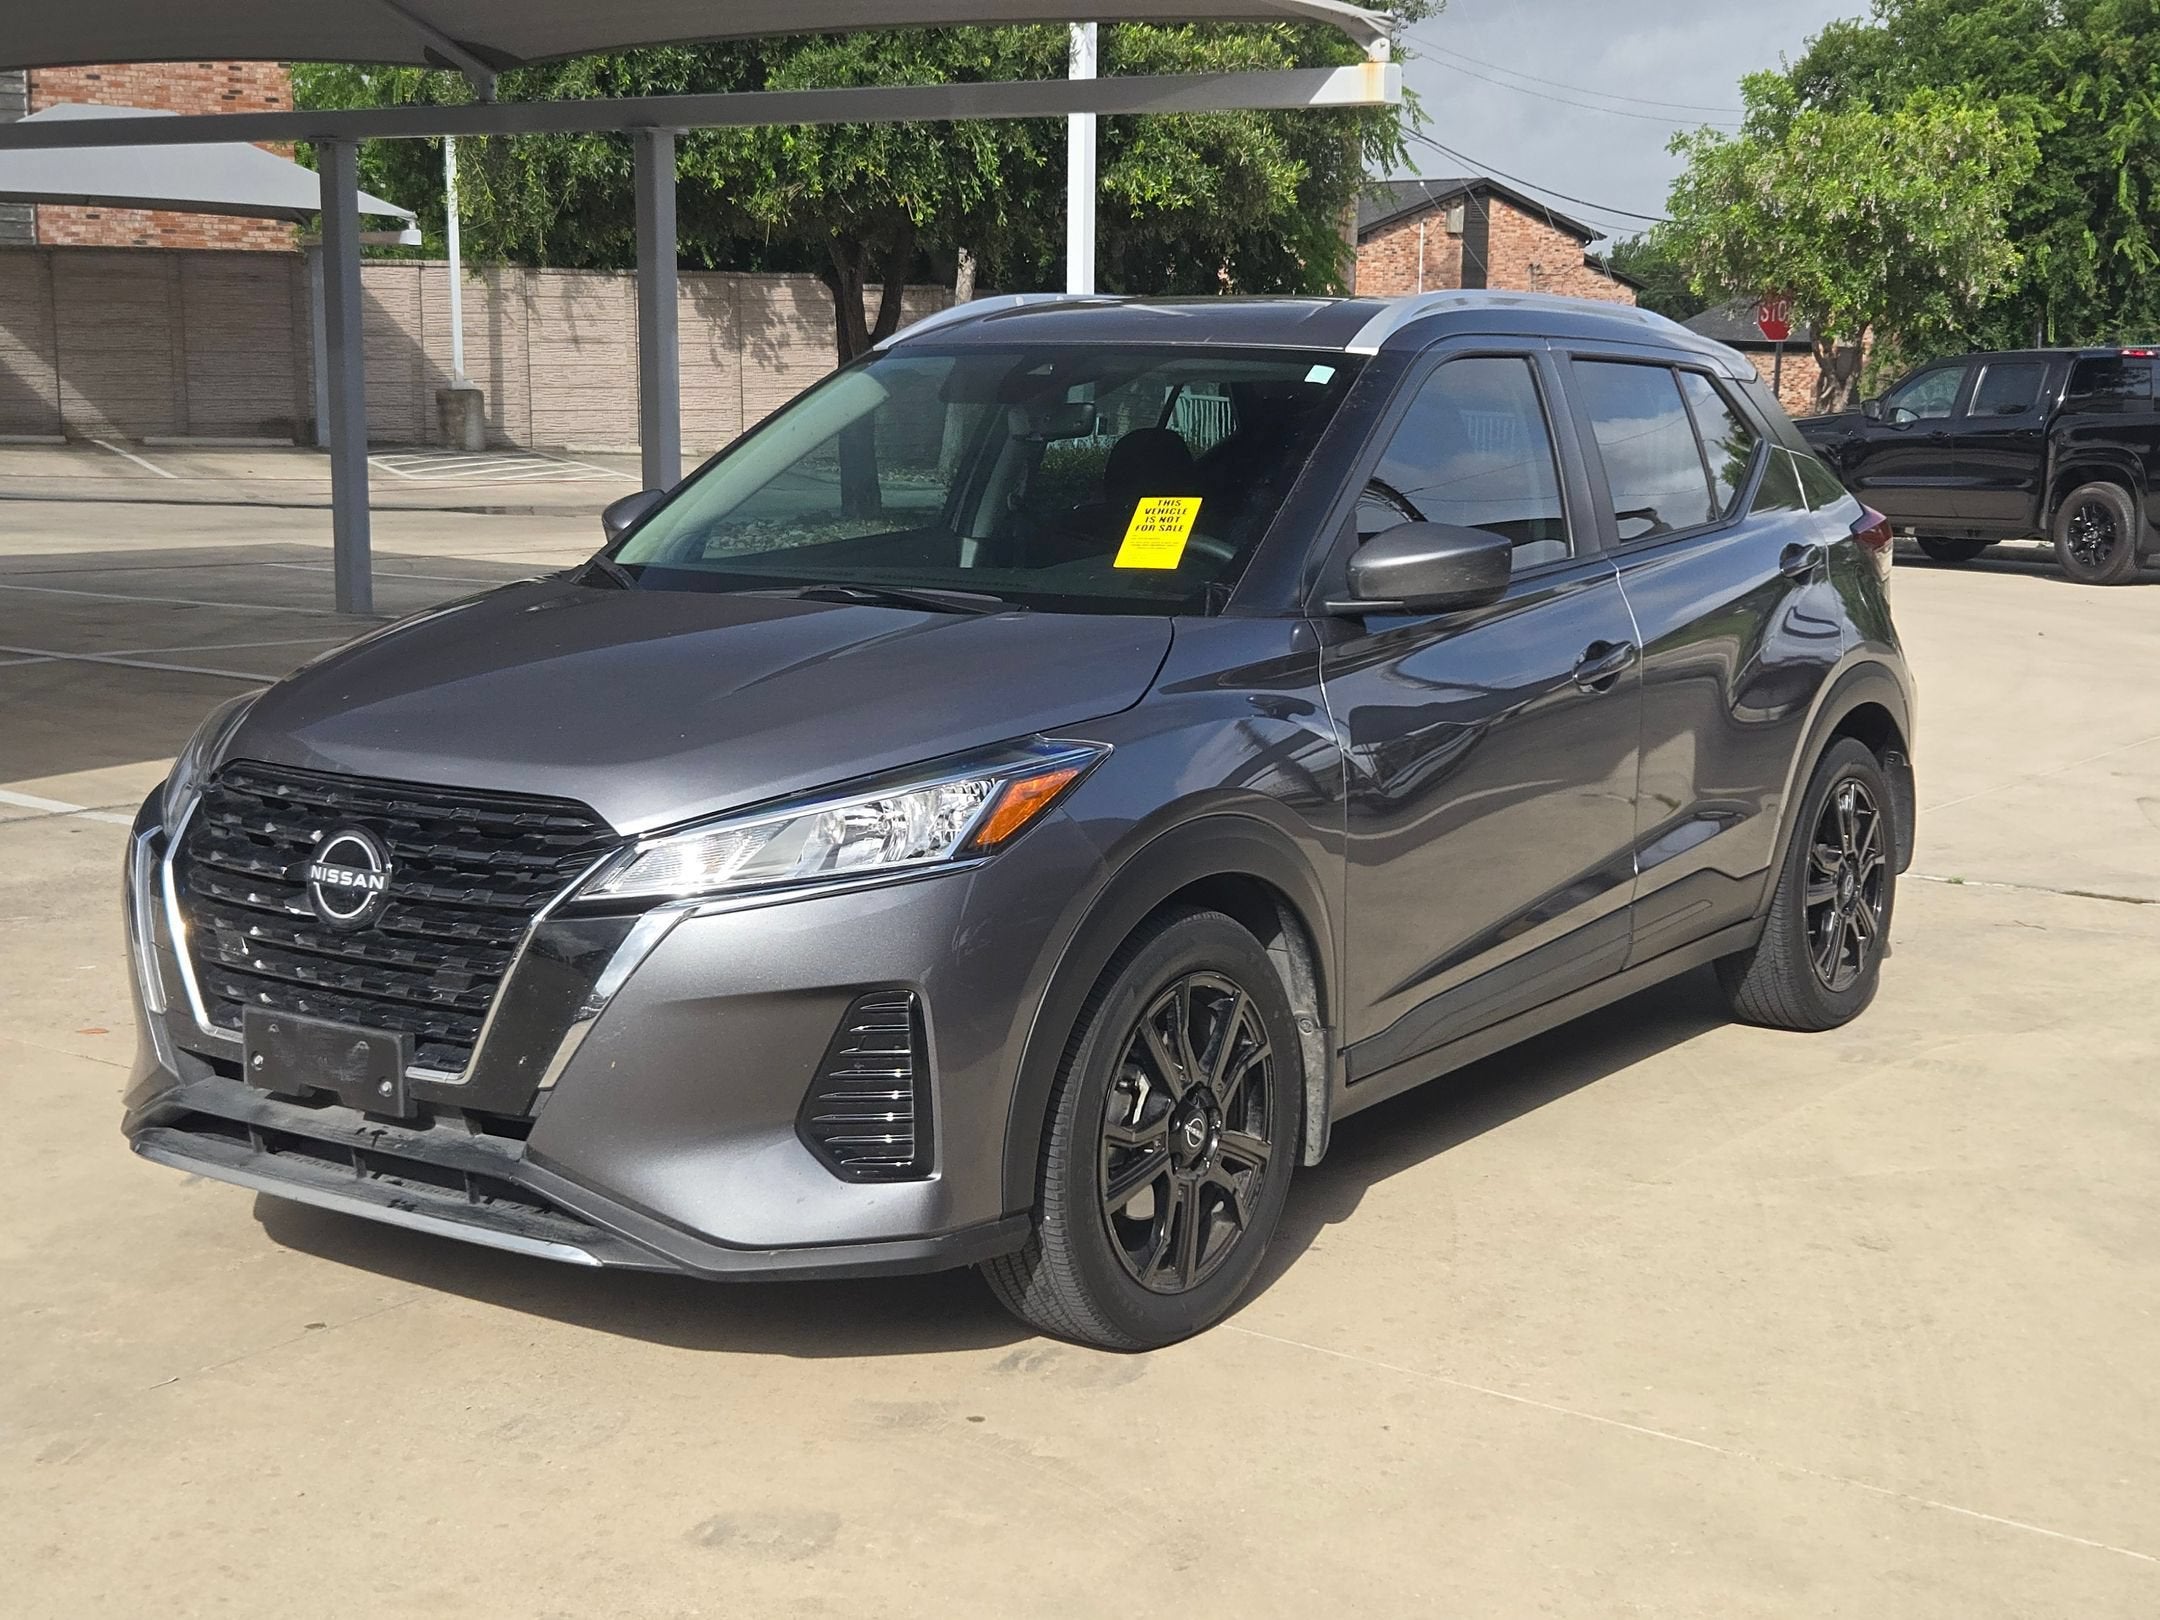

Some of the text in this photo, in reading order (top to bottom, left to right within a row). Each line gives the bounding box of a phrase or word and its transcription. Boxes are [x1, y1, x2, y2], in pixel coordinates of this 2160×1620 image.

[1760, 300, 1793, 322] STO
[1157, 499, 1182, 507] THIS
[1144, 508, 1188, 516] VEHICLE
[1135, 524, 1184, 532] FOR SALE
[310, 864, 385, 890] NISSAN
